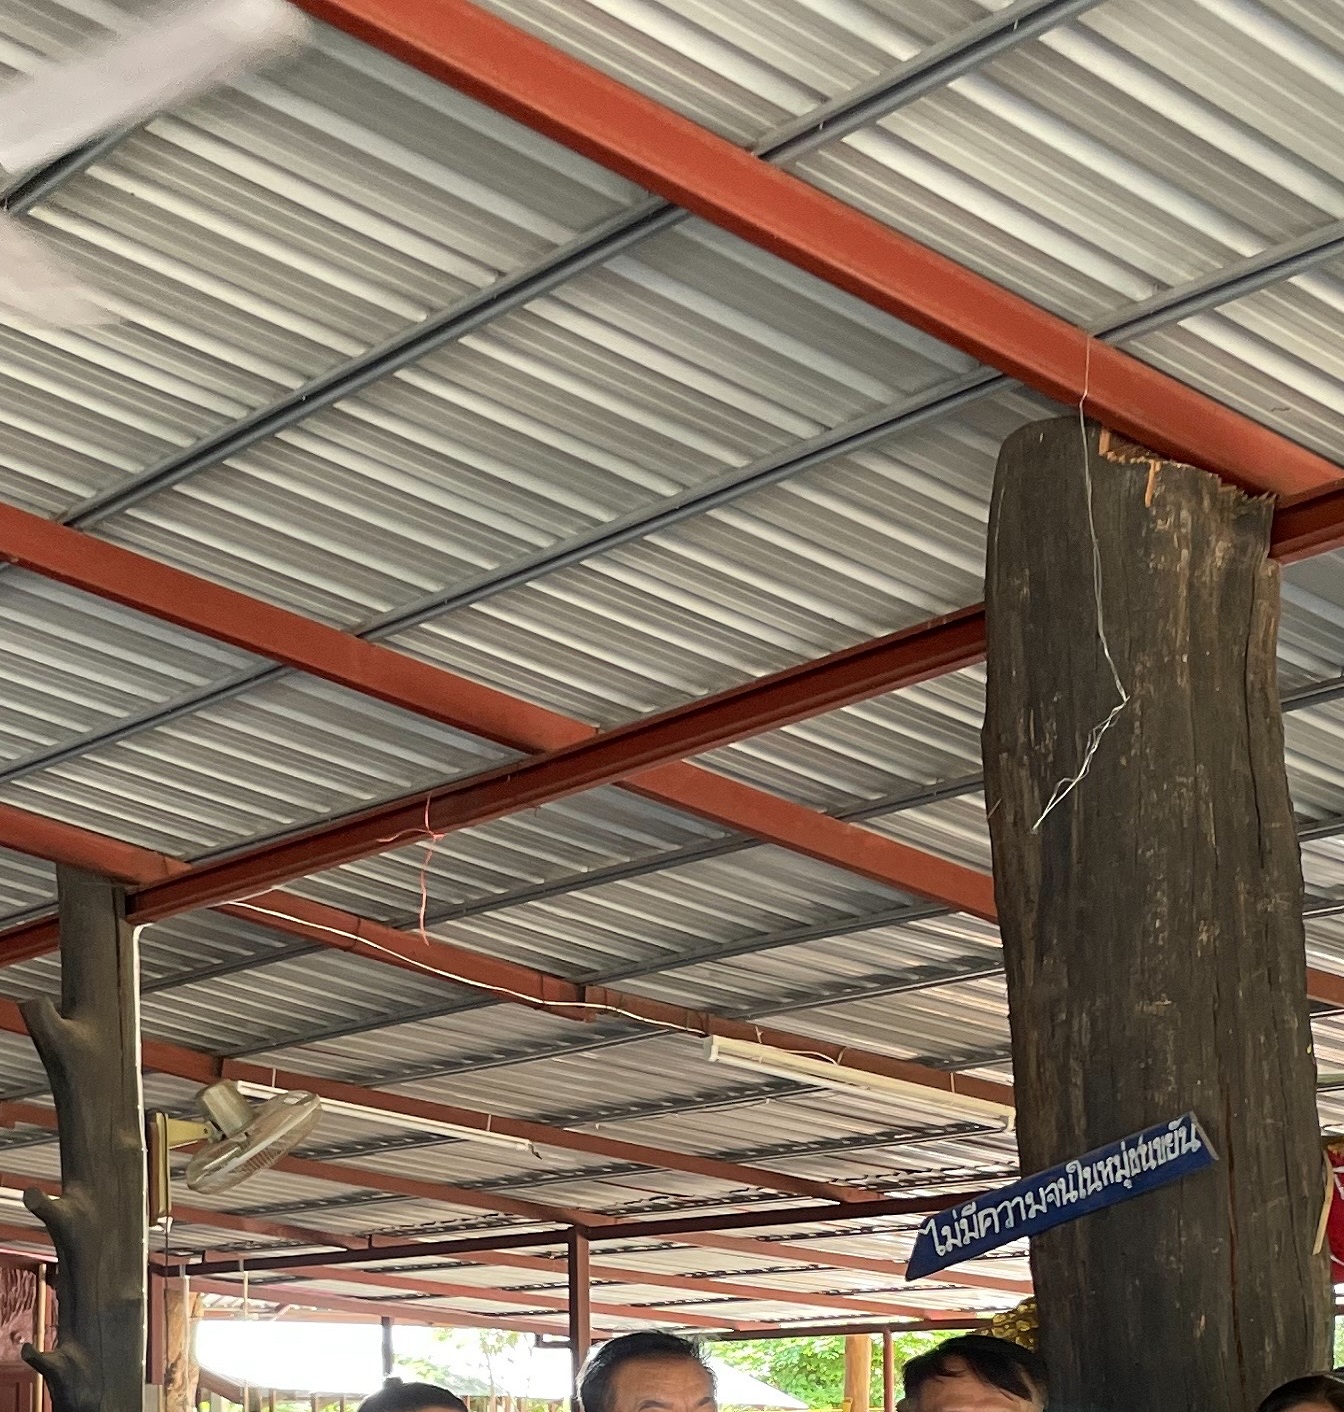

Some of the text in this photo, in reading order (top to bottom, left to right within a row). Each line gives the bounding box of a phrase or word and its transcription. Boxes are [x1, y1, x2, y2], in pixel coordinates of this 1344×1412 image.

[918, 1116, 1202, 1257] ไม่มีความจนในหมู่ชนขยัน
